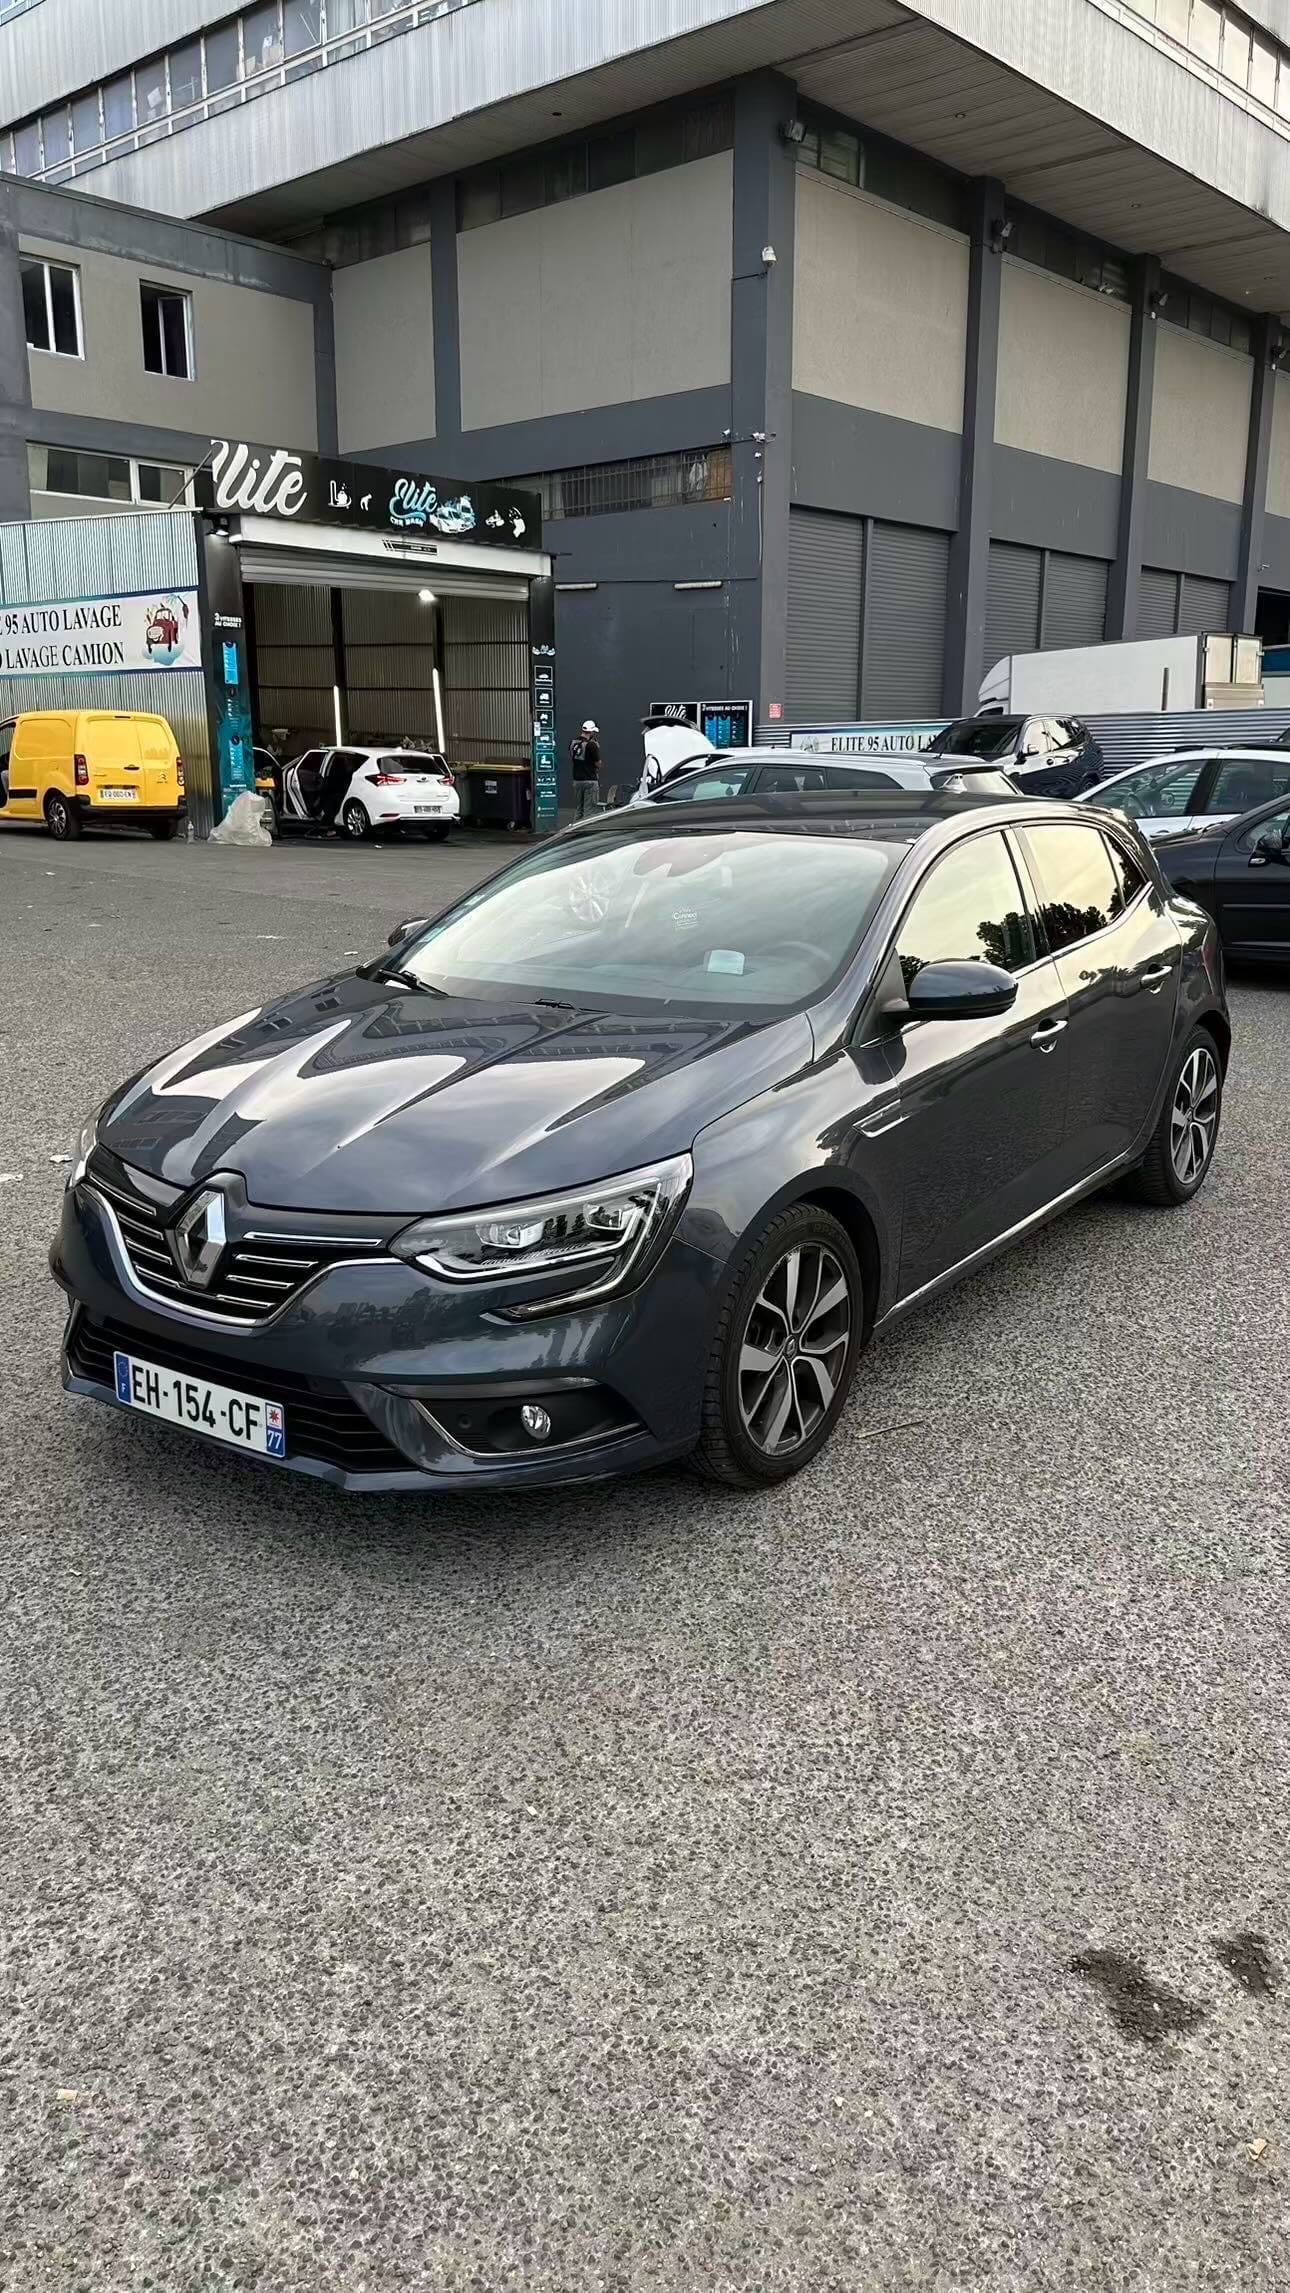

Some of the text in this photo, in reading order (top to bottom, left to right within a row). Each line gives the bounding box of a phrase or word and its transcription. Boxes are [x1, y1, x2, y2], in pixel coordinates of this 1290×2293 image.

[389, 478, 437, 519] Elite
[5, 613, 19, 636] 95
[21, 609, 59, 634] AUTO
[63, 604, 122, 631] LAVAGE
[5, 644, 59, 669] LAVAGE
[62, 641, 125, 667] CAMION
[831, 736, 864, 752] ELITE
[867, 736, 879, 752] 95
[880, 735, 914, 751] AUTO
[121, 1382, 127, 1393] F
[132, 1364, 260, 1440] EH-154-CF
[267, 1430, 283, 1449] 77
